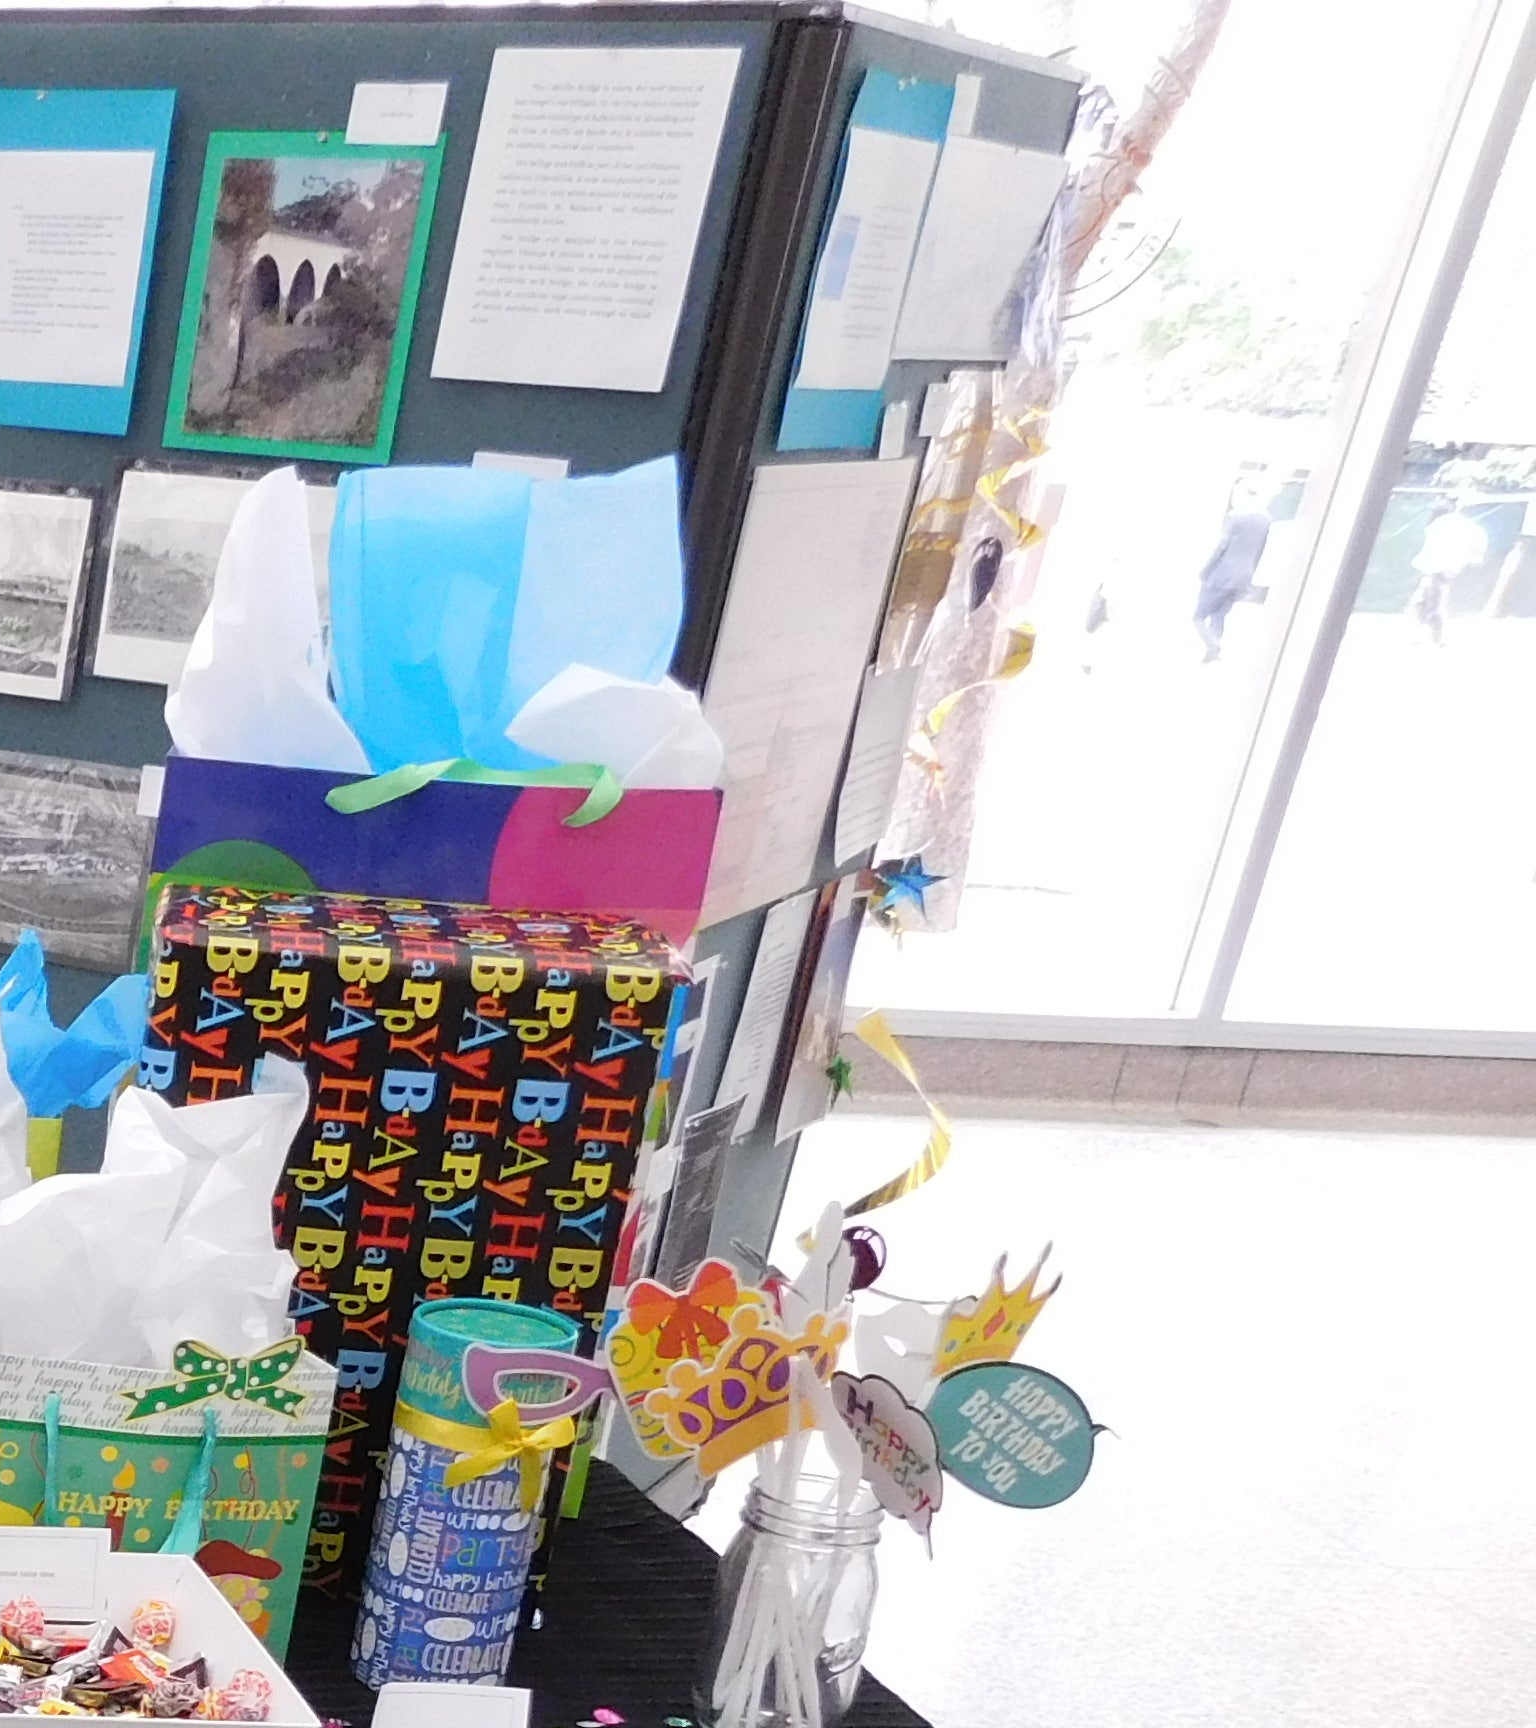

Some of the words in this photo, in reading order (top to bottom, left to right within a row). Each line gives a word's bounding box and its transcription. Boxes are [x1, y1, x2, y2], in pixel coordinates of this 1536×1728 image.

[1000, 1375, 1080, 1441] HAPPY
[949, 1428, 987, 1463] TO
[57, 1490, 153, 1520] HAPPY
